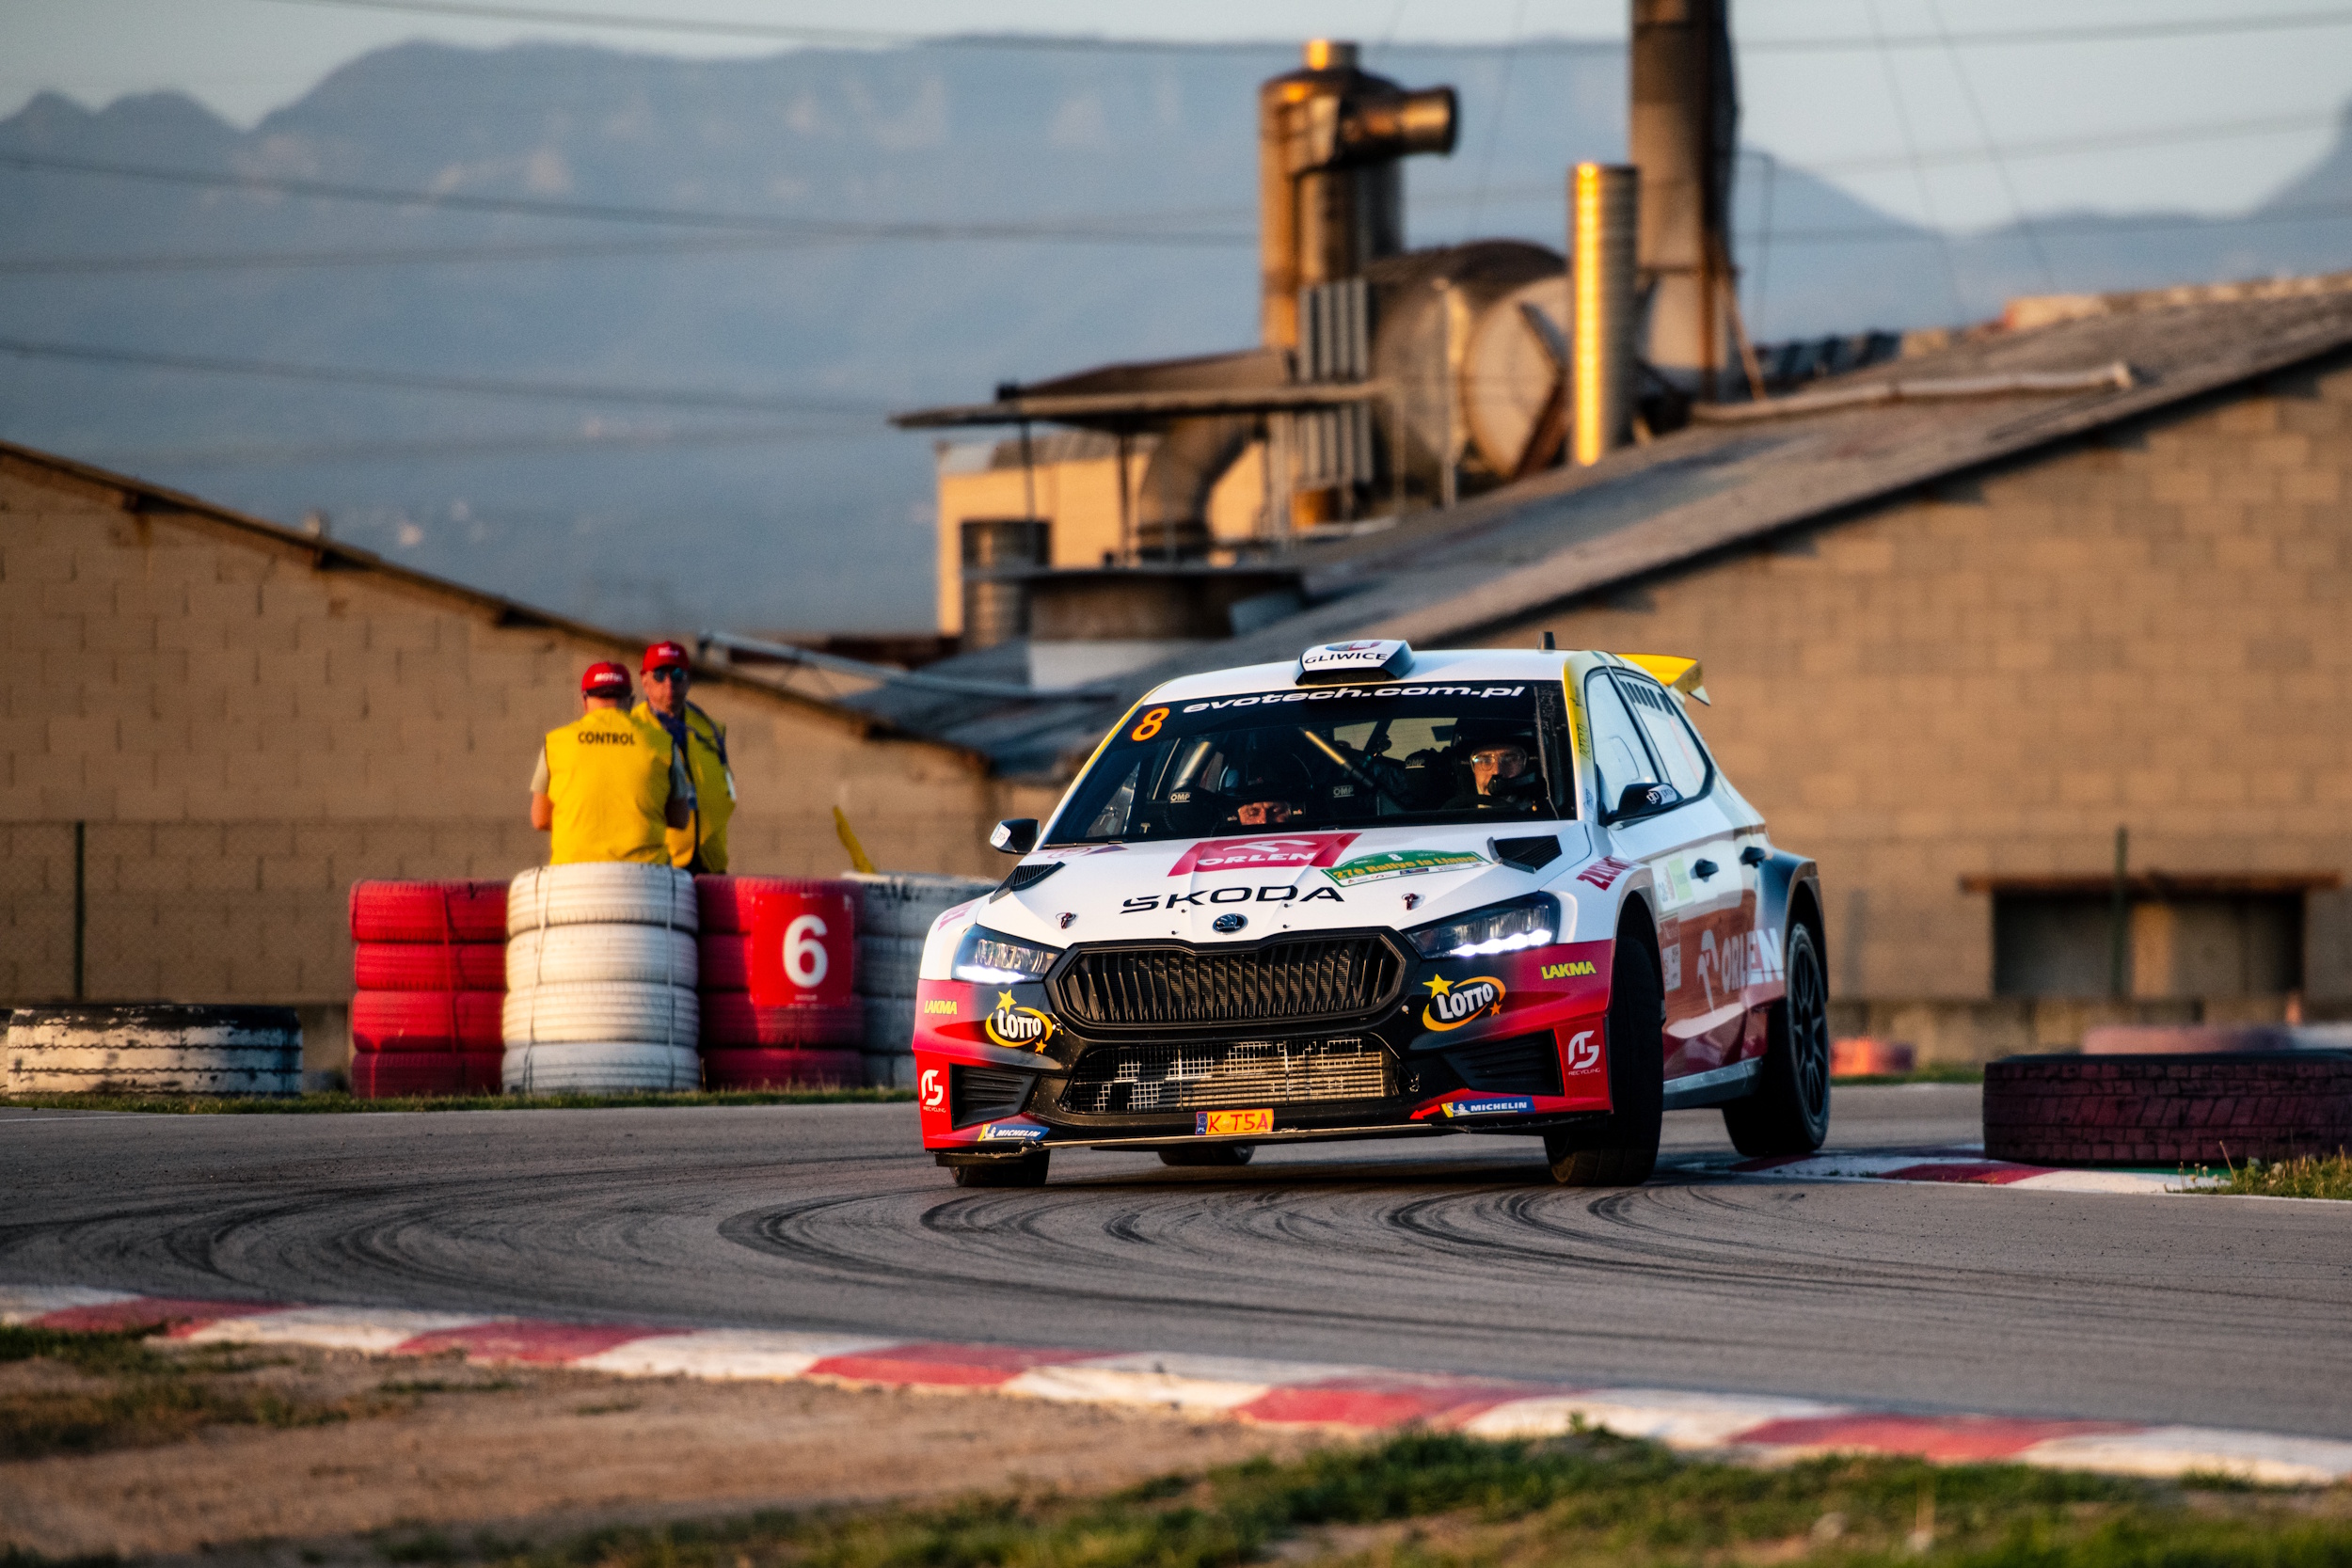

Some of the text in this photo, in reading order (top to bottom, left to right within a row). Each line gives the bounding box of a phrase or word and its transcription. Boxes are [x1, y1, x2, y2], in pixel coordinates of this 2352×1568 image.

[1304, 652, 1389, 664] GLIWICE
[1183, 686, 1526, 714] evotech.com.pl
[1131, 706, 1170, 742] 8
[578, 730, 635, 746] CONTROL
[1170, 792, 1191, 802] OMP
[1333, 786, 1354, 798] OMP
[1198, 851, 1317, 866] ORLEN
[1387, 853, 1404, 862] 8
[1365, 860, 1416, 874] Rallye
[1416, 858, 1435, 866] la
[783, 914, 829, 989] 6
[1722, 927, 1784, 994] ORLEN
[1540, 961, 1597, 980] LAKMA
[924, 1000, 958, 1015] LAKMA
[1436, 983, 1494, 1020] LOTTO
[997, 1009, 1042, 1038] LOTTO
[1568, 1068, 1601, 1076] RECYCLING
[1470, 1101, 1528, 1112] MICHELIN
[1208, 1115, 1222, 1132] K
[1230, 1113, 1269, 1131] T5A
[996, 1129, 1041, 1138] MICHELIN
